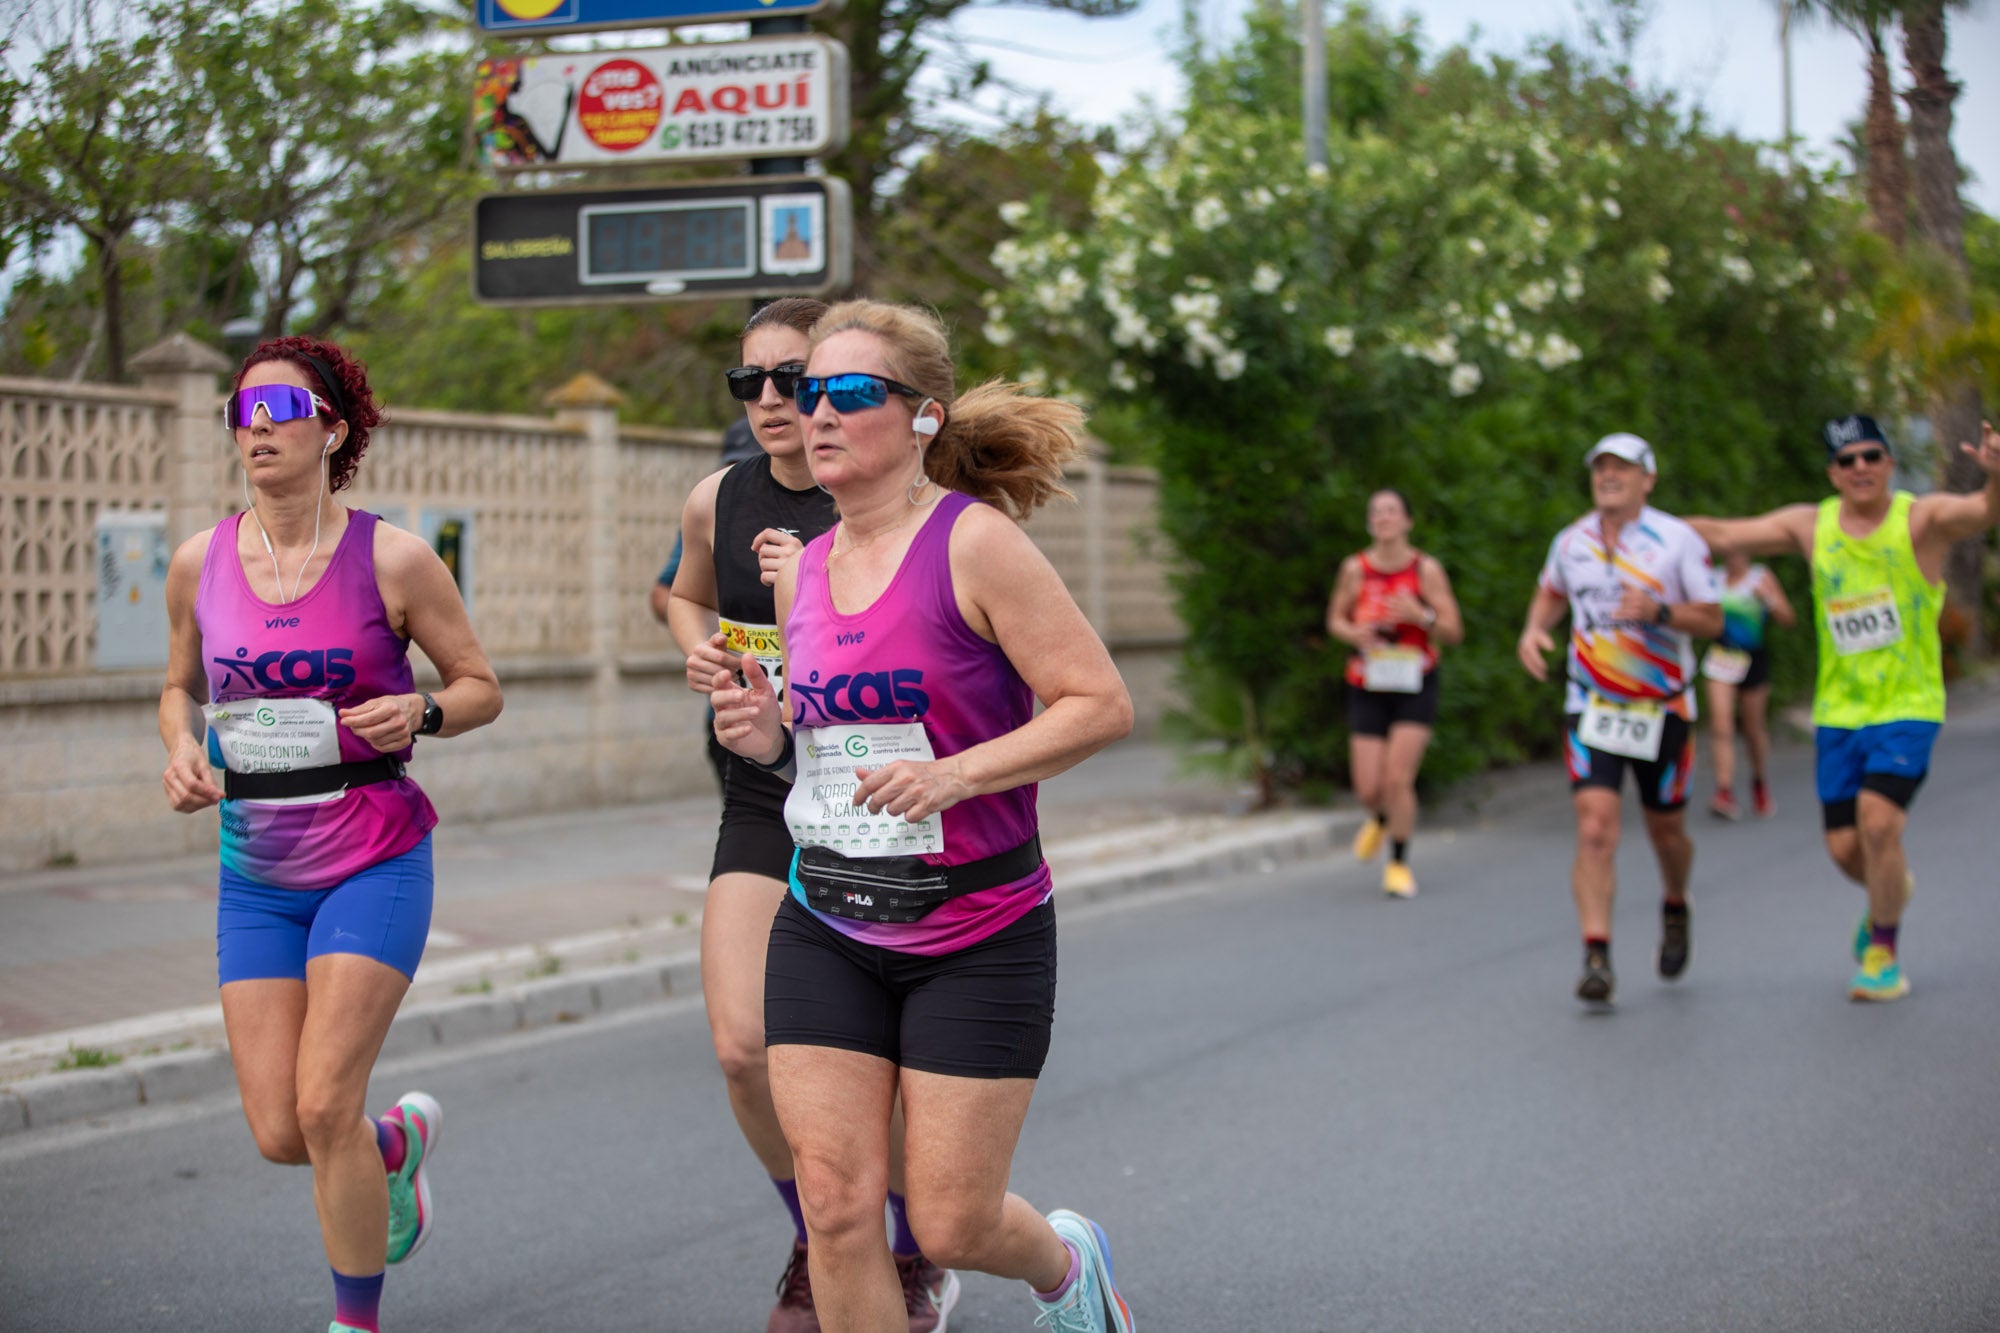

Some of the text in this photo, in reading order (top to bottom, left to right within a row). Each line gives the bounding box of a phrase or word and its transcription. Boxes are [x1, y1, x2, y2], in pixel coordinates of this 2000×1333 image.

[668, 51, 817, 76] ANÚNCIATE
[602, 84, 661, 111] ves?
[672, 73, 812, 115] AQUÍ
[734, 120, 769, 145] 472
[265, 616, 300, 629] vive
[1833, 609, 1898, 640] 1003
[732, 628, 747, 646] 38
[836, 631, 865, 646] vive
[253, 648, 356, 689] cas
[824, 669, 930, 721] cas
[268, 745, 310, 758] CONTRA
[846, 892, 873, 906] FILA
